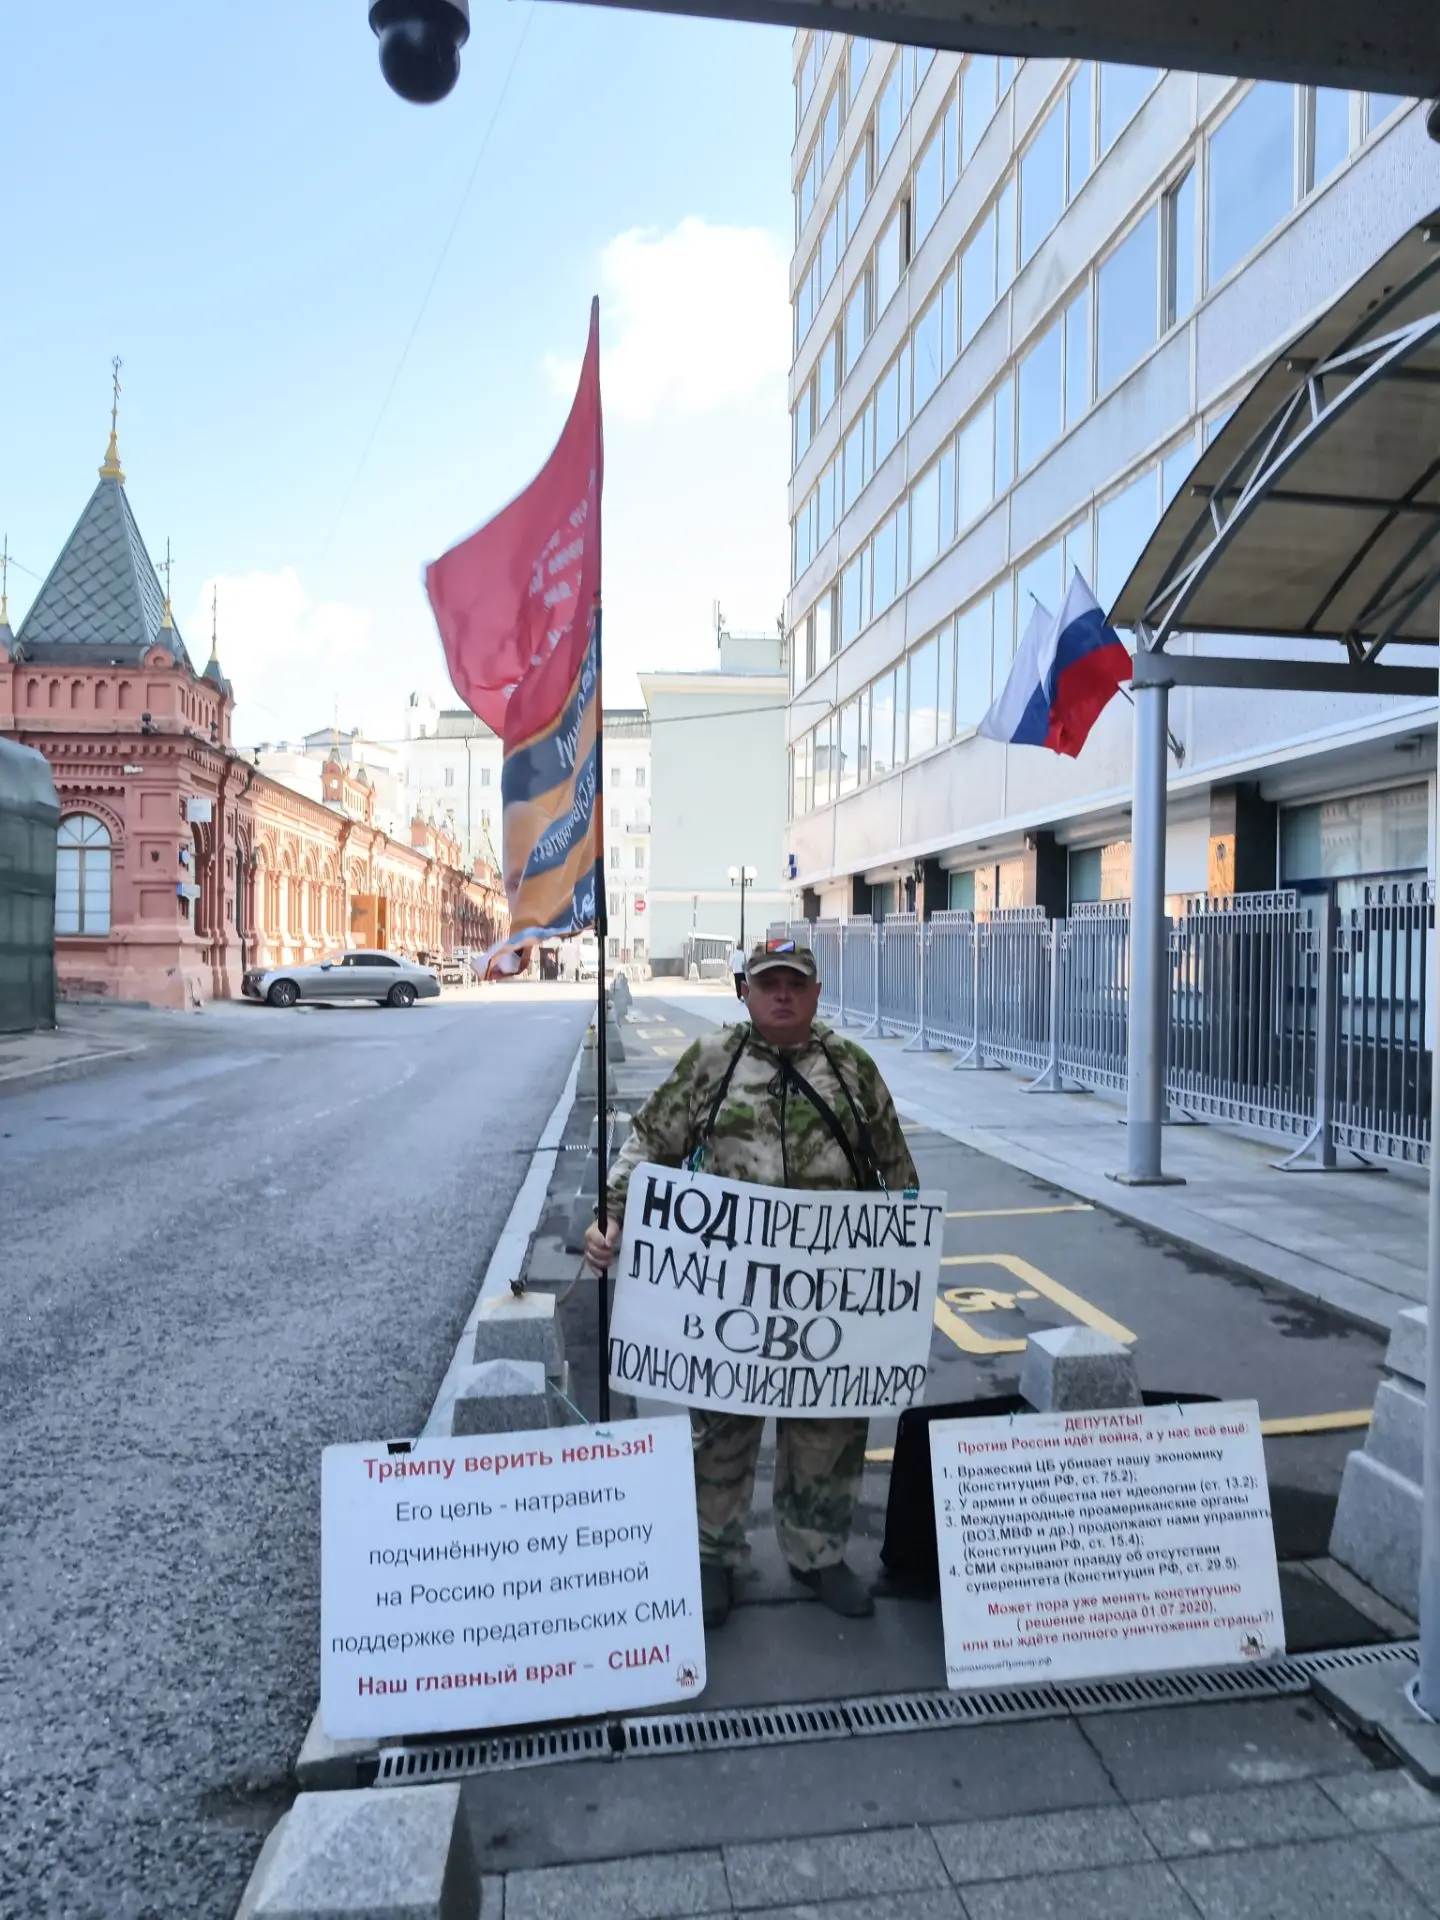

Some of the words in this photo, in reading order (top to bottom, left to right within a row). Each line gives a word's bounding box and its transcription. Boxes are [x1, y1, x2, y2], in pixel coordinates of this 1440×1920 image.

[642, 1175, 739, 1252] НОД
[744, 1196, 943, 1256] ПРЕДЛАГАЕТ
[628, 1239, 727, 1300] ПЛАН
[739, 1260, 921, 1316] ПОБЕДЫ
[714, 1309, 842, 1363] СВО
[957, 1439, 1008, 1456] Против
[1011, 1436, 1060, 1450] России
[1064, 1433, 1094, 1447] идёт
[1099, 1429, 1143, 1444] война,
[1146, 1430, 1154, 1441] а
[1157, 1429, 1165, 1443] у
[1168, 1427, 1191, 1438] нас
[1194, 1424, 1216, 1437] всё
[363, 1455, 455, 1483] Трампу
[464, 1450, 553, 1473] верить
[561, 1434, 655, 1464] нельзя!
[943, 1466, 953, 1479] 1.
[957, 1462, 1032, 1480] Вражеский
[1036, 1458, 1056, 1473] ЦБ
[1059, 1456, 1113, 1473] убивает
[1117, 1454, 1151, 1468] нашу
[1155, 1448, 1224, 1463] экономику
[959, 1498, 968, 1511] У
[972, 1496, 1015, 1511] армии
[1019, 1495, 1027, 1506] и
[1031, 1489, 1097, 1506] общества
[1101, 1488, 1122, 1499] нет
[1126, 1483, 1197, 1498] идеологии
[1200, 1480, 1221, 1494] (ст.
[1054, 1474, 1079, 1487] РФ,
[1082, 1474, 1100, 1486] ст.
[396, 1500, 433, 1522] Его
[440, 1497, 493, 1521] цель
[514, 1485, 626, 1513] натравить
[960, 1508, 1075, 1528] Международные
[1079, 1499, 1197, 1518] проамериканские
[1201, 1494, 1249, 1509] органы
[1037, 1526, 1046, 1537] и
[1078, 1517, 1162, 1534] продолжают
[1166, 1513, 1200, 1527] нами
[1203, 1508, 1271, 1527] управлять
[369, 1539, 520, 1568] подчинённую
[527, 1532, 568, 1555] ему
[576, 1521, 653, 1548] Европу
[964, 1562, 997, 1576] СМИ
[1000, 1557, 1070, 1574] скрывают
[1073, 1552, 1122, 1568] правду
[1126, 1549, 1143, 1561] об
[1146, 1545, 1221, 1562] отсутствии
[1089, 1538, 1106, 1549] ст.
[376, 1588, 402, 1607] на
[410, 1581, 495, 1605] Россию
[502, 1578, 543, 1601] при
[549, 1560, 650, 1591] активной
[966, 1574, 1060, 1593] суверенитета
[1158, 1562, 1183, 1576] РФ,
[1186, 1562, 1204, 1573] ст.
[988, 1602, 1033, 1616] Может
[1036, 1599, 1069, 1614] пора
[1072, 1596, 1098, 1611] уже
[1101, 1592, 1151, 1605] менять
[1154, 1582, 1242, 1600] конституцию
[331, 1627, 455, 1655] поддержке
[462, 1608, 627, 1646] предательских
[635, 1597, 693, 1623] СМИ.
[962, 1639, 989, 1652] или
[993, 1637, 1013, 1650] вы
[1017, 1632, 1058, 1648] ждёте
[1062, 1627, 1119, 1643] полного
[1213, 1609, 1274, 1629] страны?!
[1025, 1614, 1085, 1631] решение
[1089, 1608, 1138, 1625] народа
[357, 1675, 408, 1697] Наш
[415, 1661, 517, 1692] главный
[525, 1660, 577, 1682] враг
[607, 1644, 671, 1670] США!
